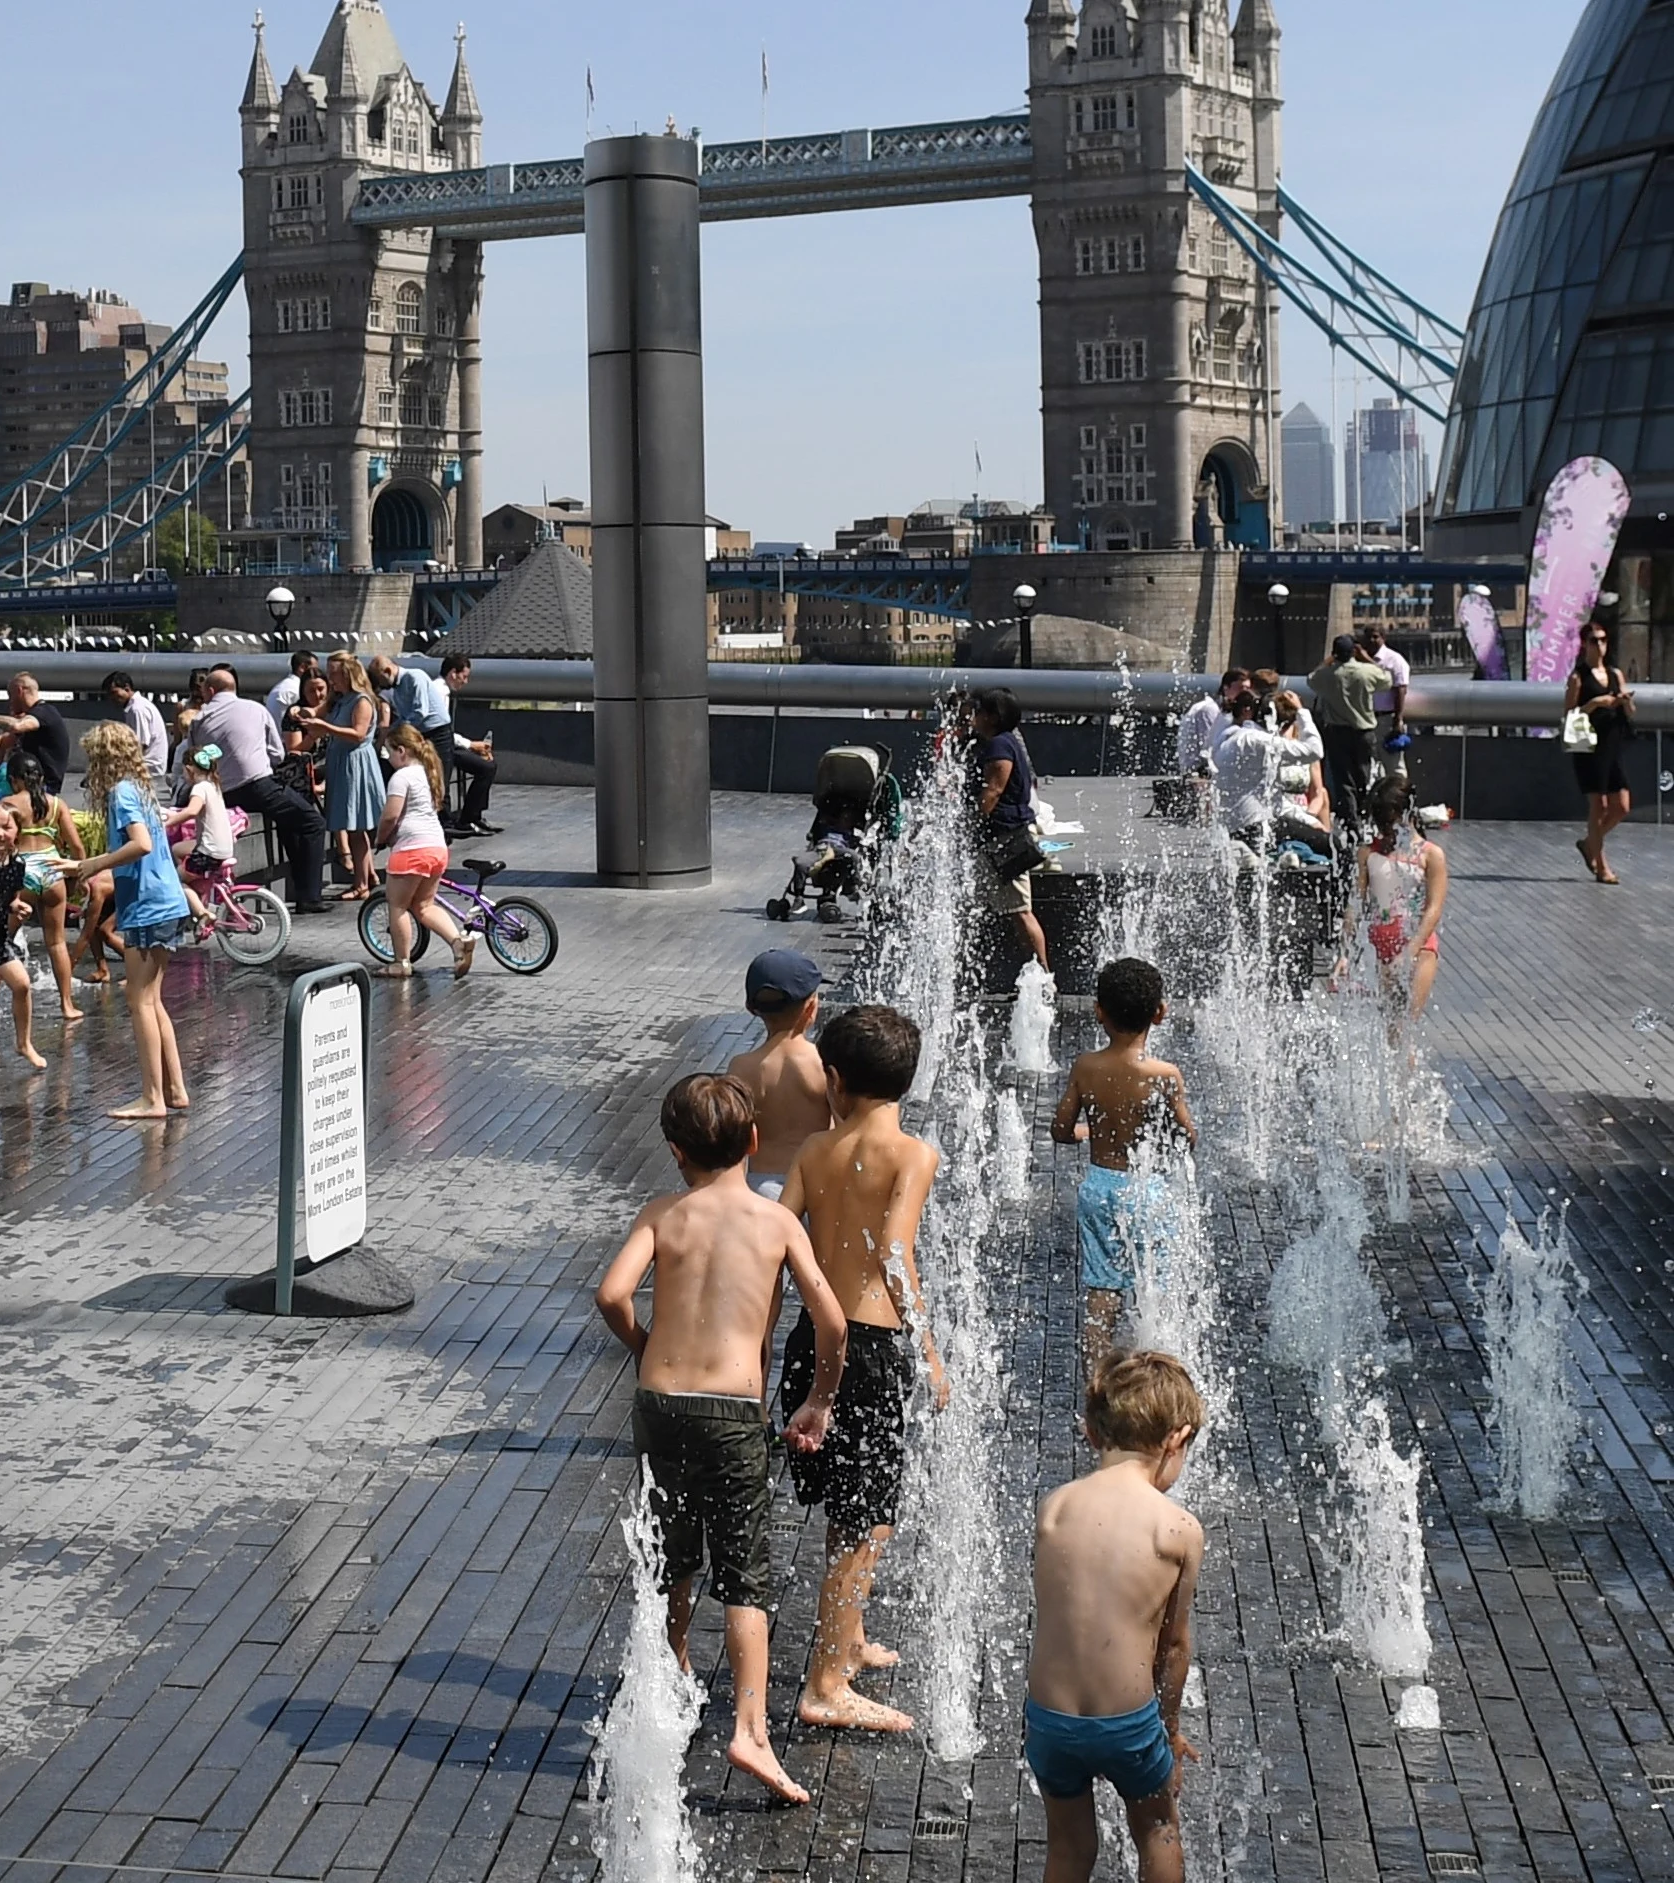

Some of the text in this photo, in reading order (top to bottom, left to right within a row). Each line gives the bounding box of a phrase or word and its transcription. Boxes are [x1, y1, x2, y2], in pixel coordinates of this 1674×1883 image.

[314, 1023, 348, 1048] Parents and
[312, 1047, 351, 1073] guardians are
[307, 1062, 357, 1096] politely requested
[315, 1087, 350, 1109] to keep their
[312, 1107, 353, 1132] charges under
[309, 1126, 358, 1154] close supervision
[324, 1154, 340, 1169] times
[341, 1144, 358, 1161] whilst
[314, 1168, 354, 1195] they are on the
[307, 1186, 363, 1219] More London Estate
